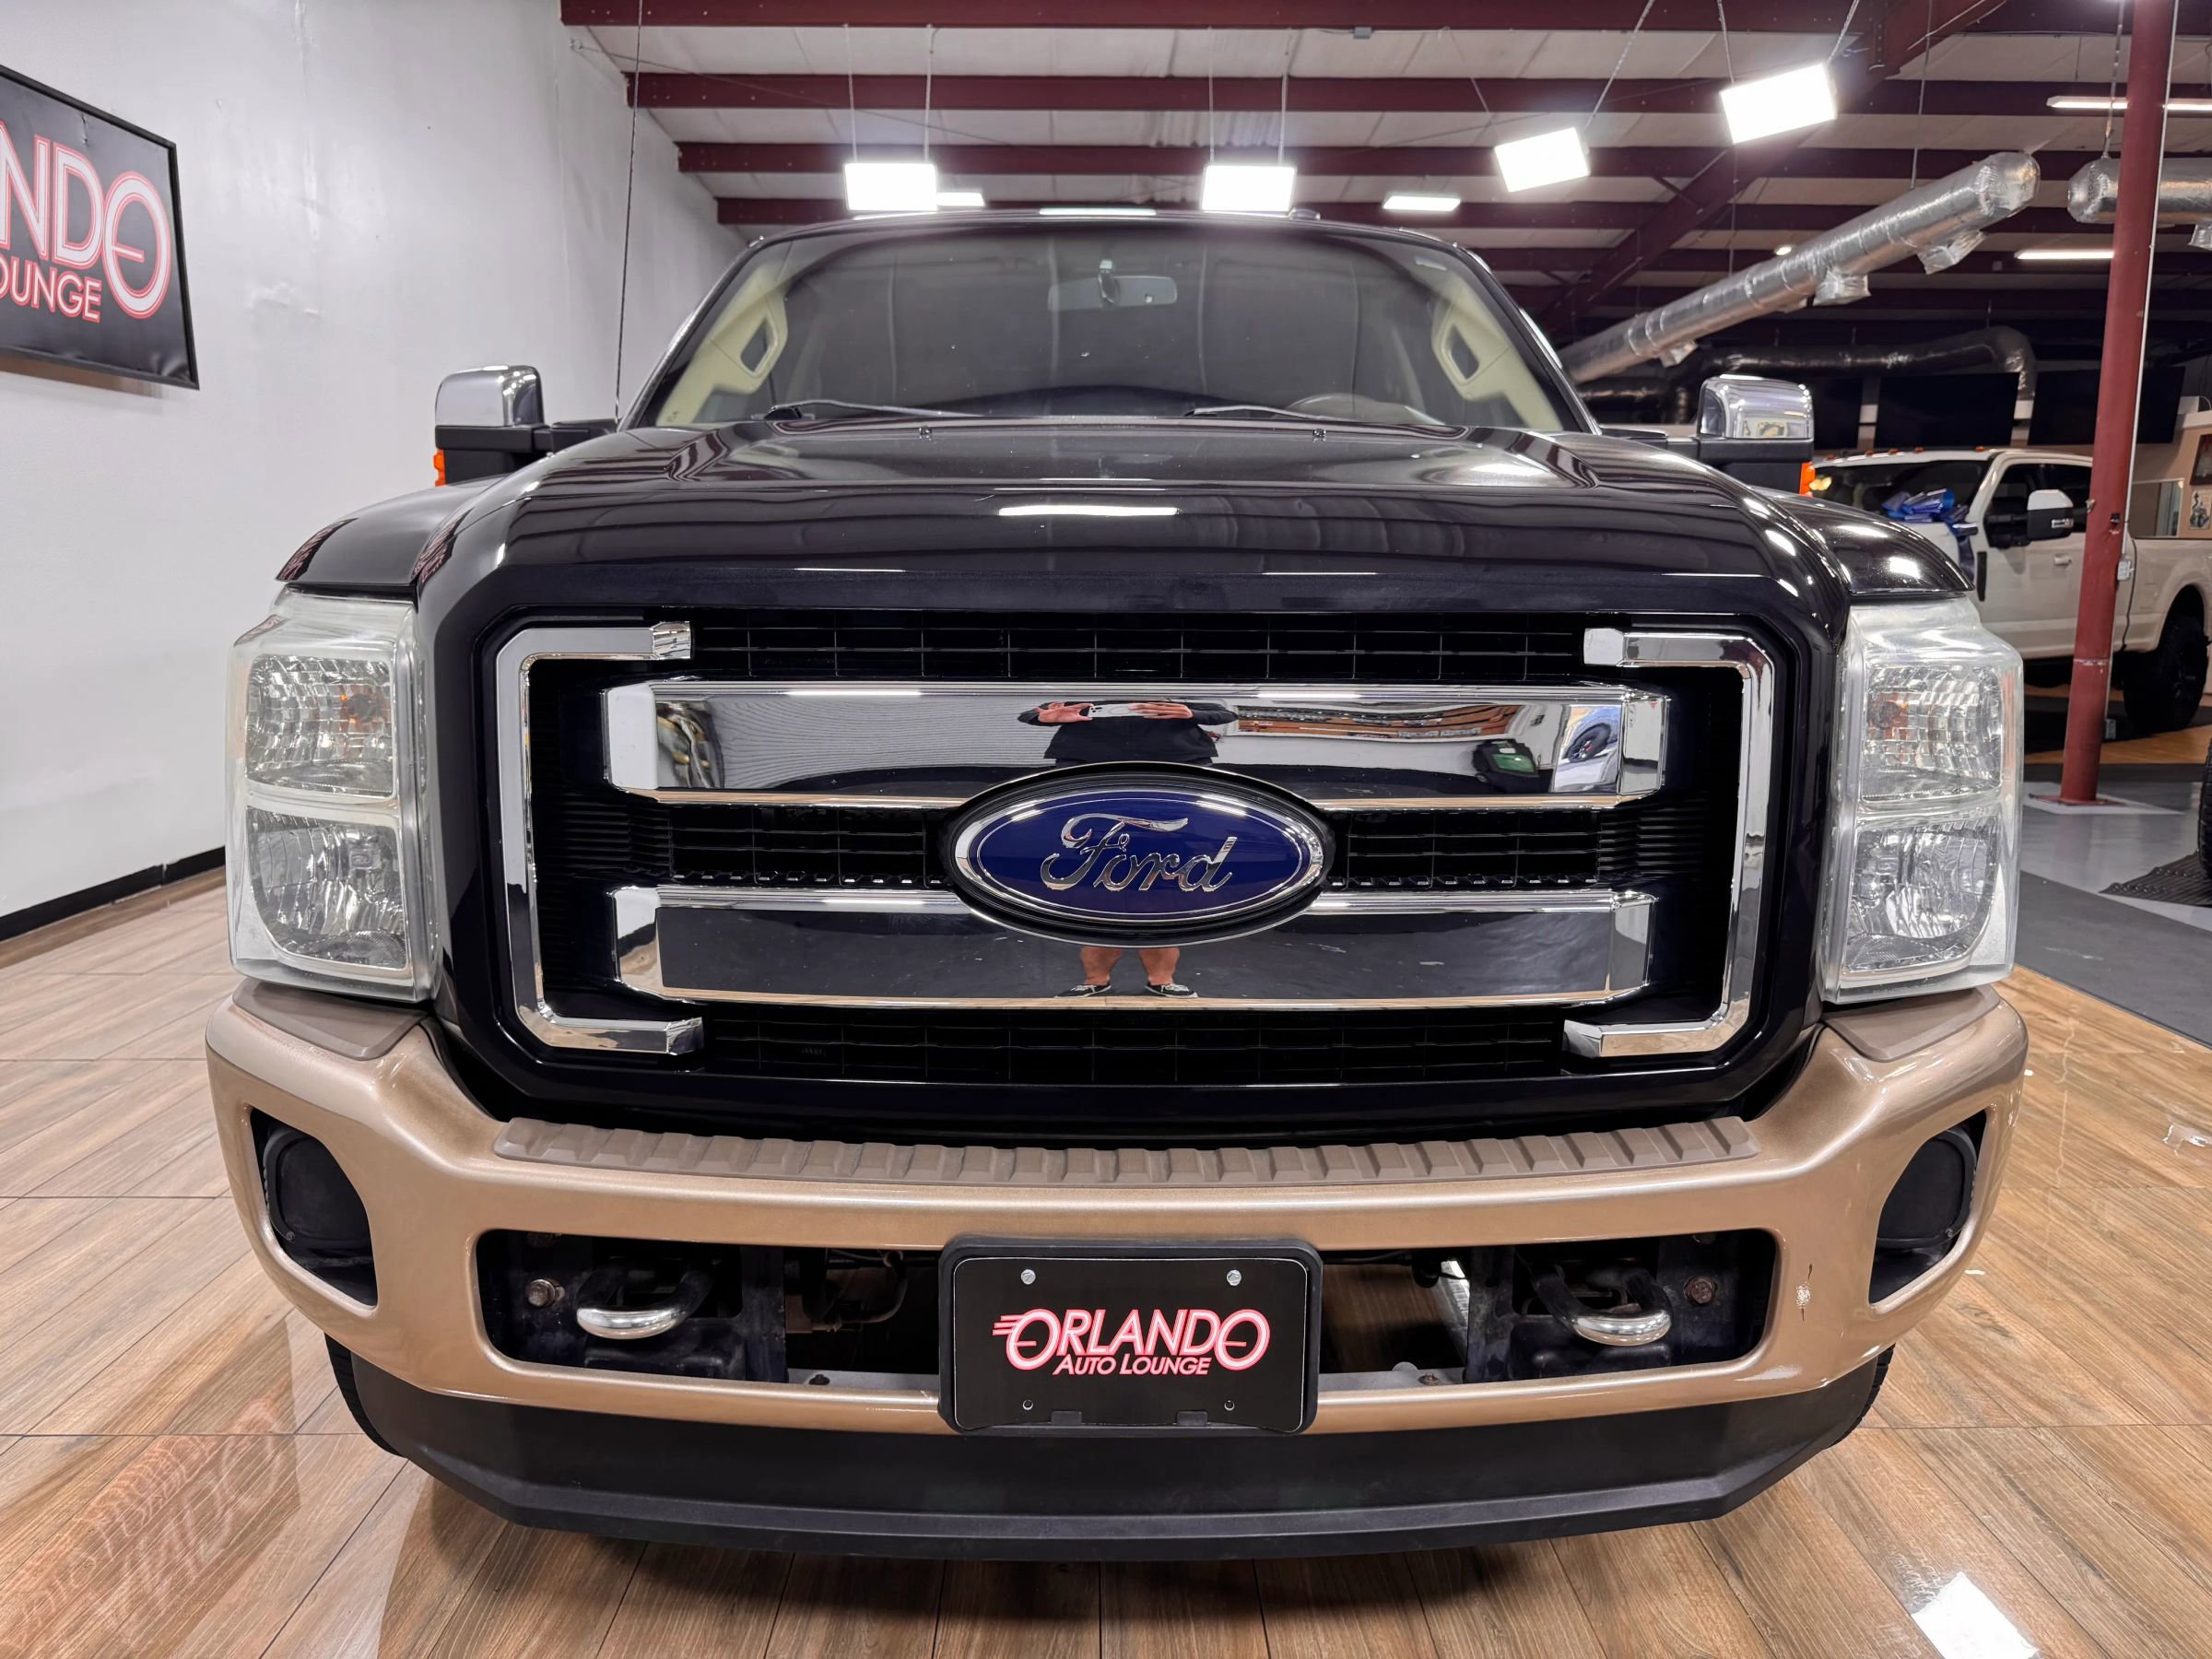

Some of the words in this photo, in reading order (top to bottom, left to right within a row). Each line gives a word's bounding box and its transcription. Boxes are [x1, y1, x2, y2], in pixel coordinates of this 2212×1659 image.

[1040, 813, 1237, 891] Ford
[1005, 1308, 1271, 1371] ORLANDO
[1052, 1352, 1117, 1375] AUTO
[1119, 1352, 1213, 1375] LOUNGE
